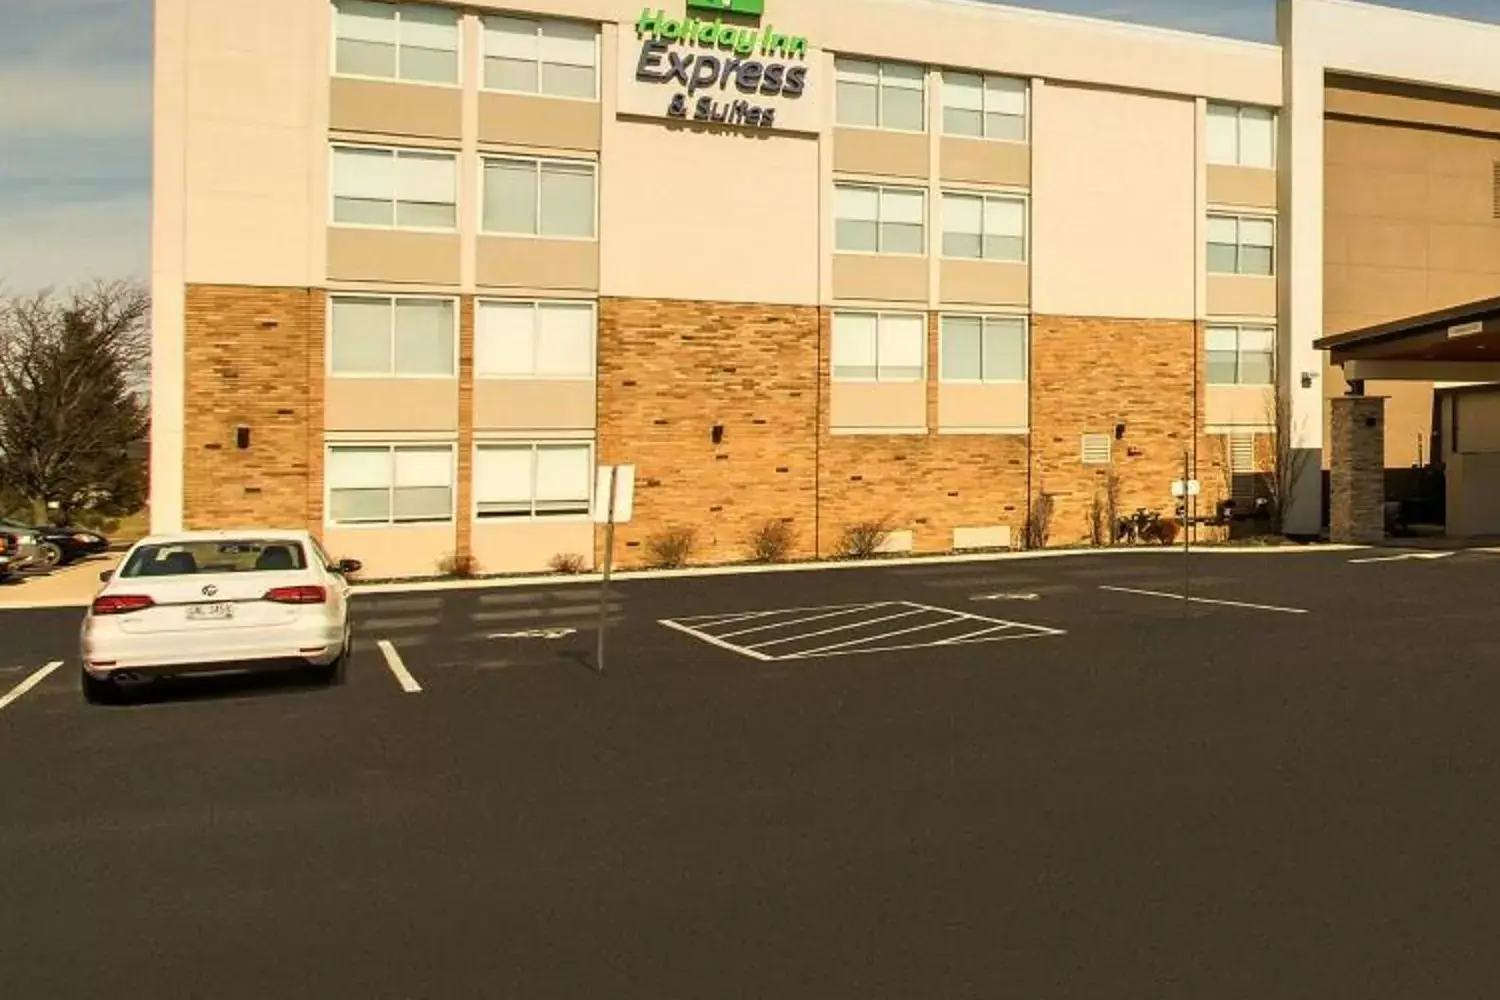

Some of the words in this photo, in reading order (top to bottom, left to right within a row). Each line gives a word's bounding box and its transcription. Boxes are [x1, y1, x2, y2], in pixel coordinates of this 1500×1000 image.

[638, 8, 757, 56] Holiday
[762, 25, 808, 57] Inn
[637, 40, 808, 97] Express
[668, 93, 686, 117] &
[694, 96, 776, 126] Suites
